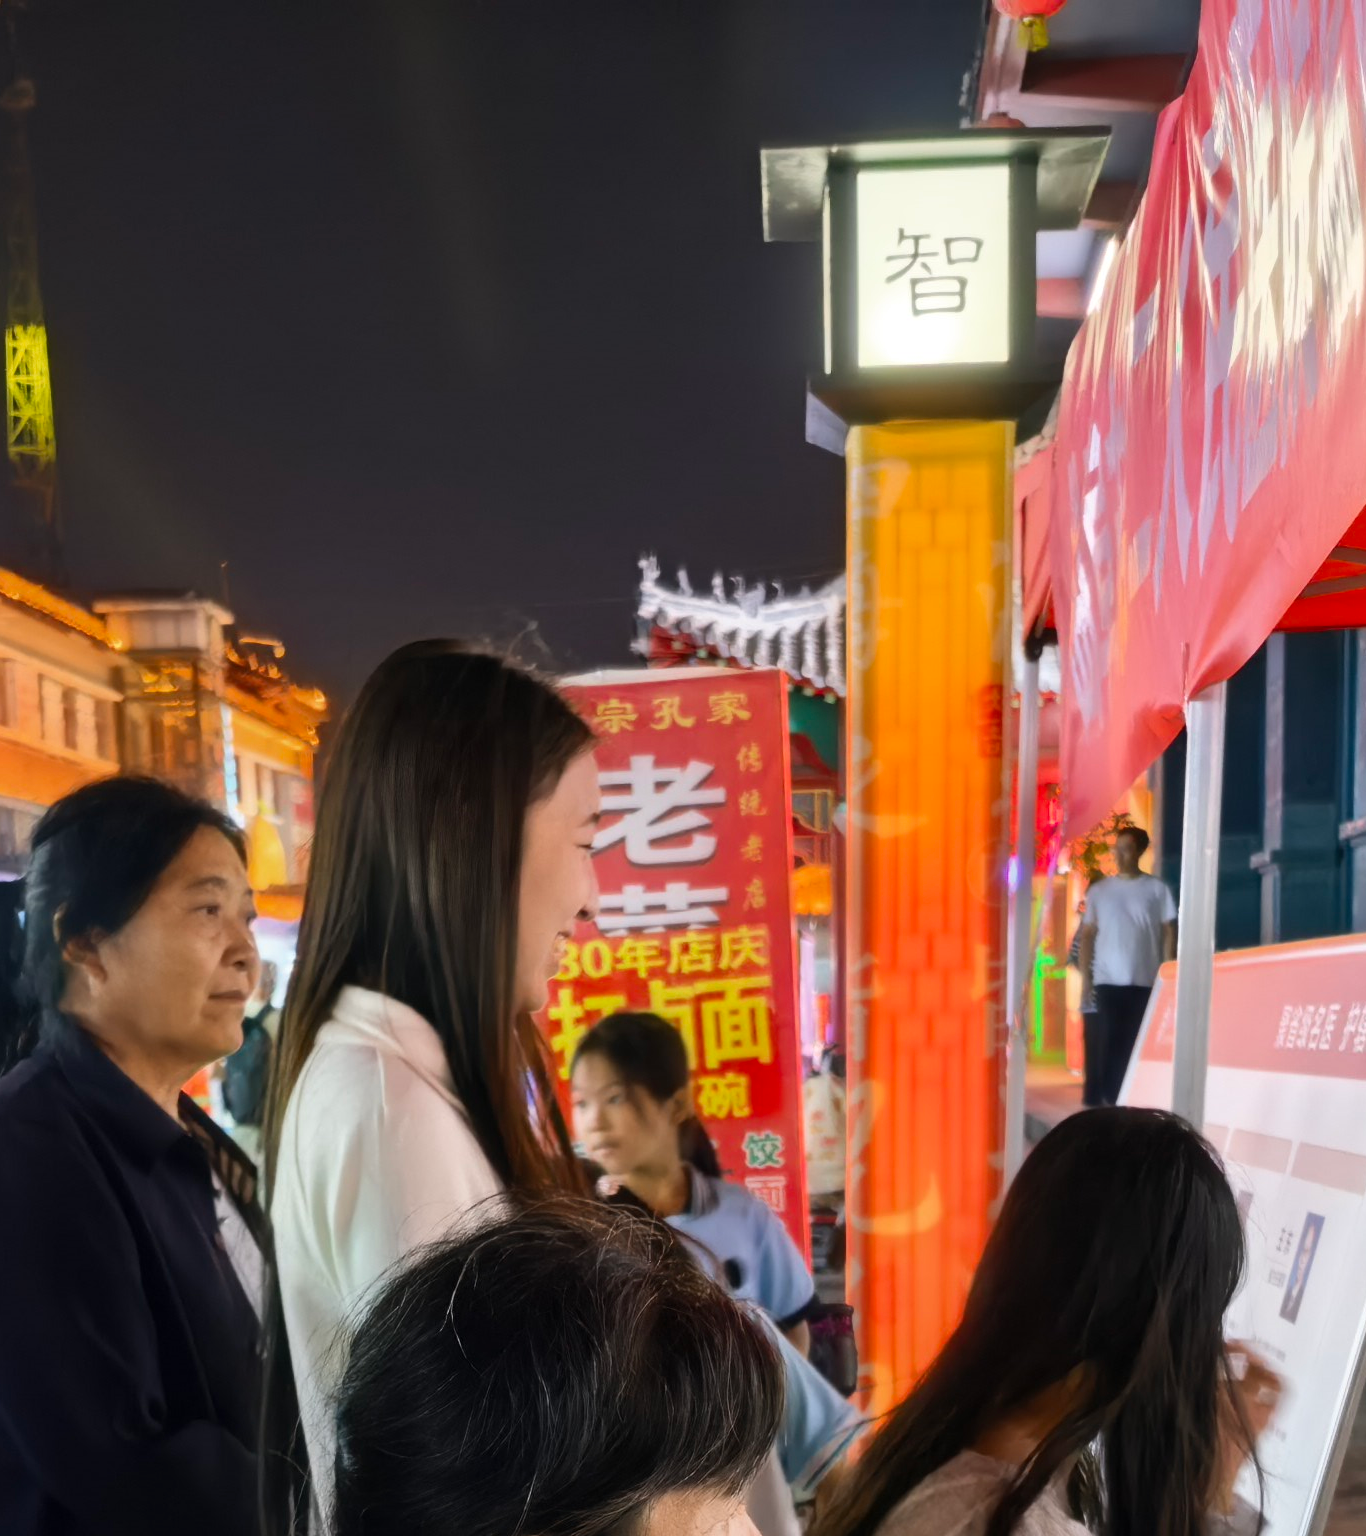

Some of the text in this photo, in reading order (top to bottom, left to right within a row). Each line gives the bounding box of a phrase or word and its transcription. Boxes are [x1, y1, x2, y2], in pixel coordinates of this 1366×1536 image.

[885, 227, 983, 316] 智
[553, 924, 770, 982] 30年店庆
